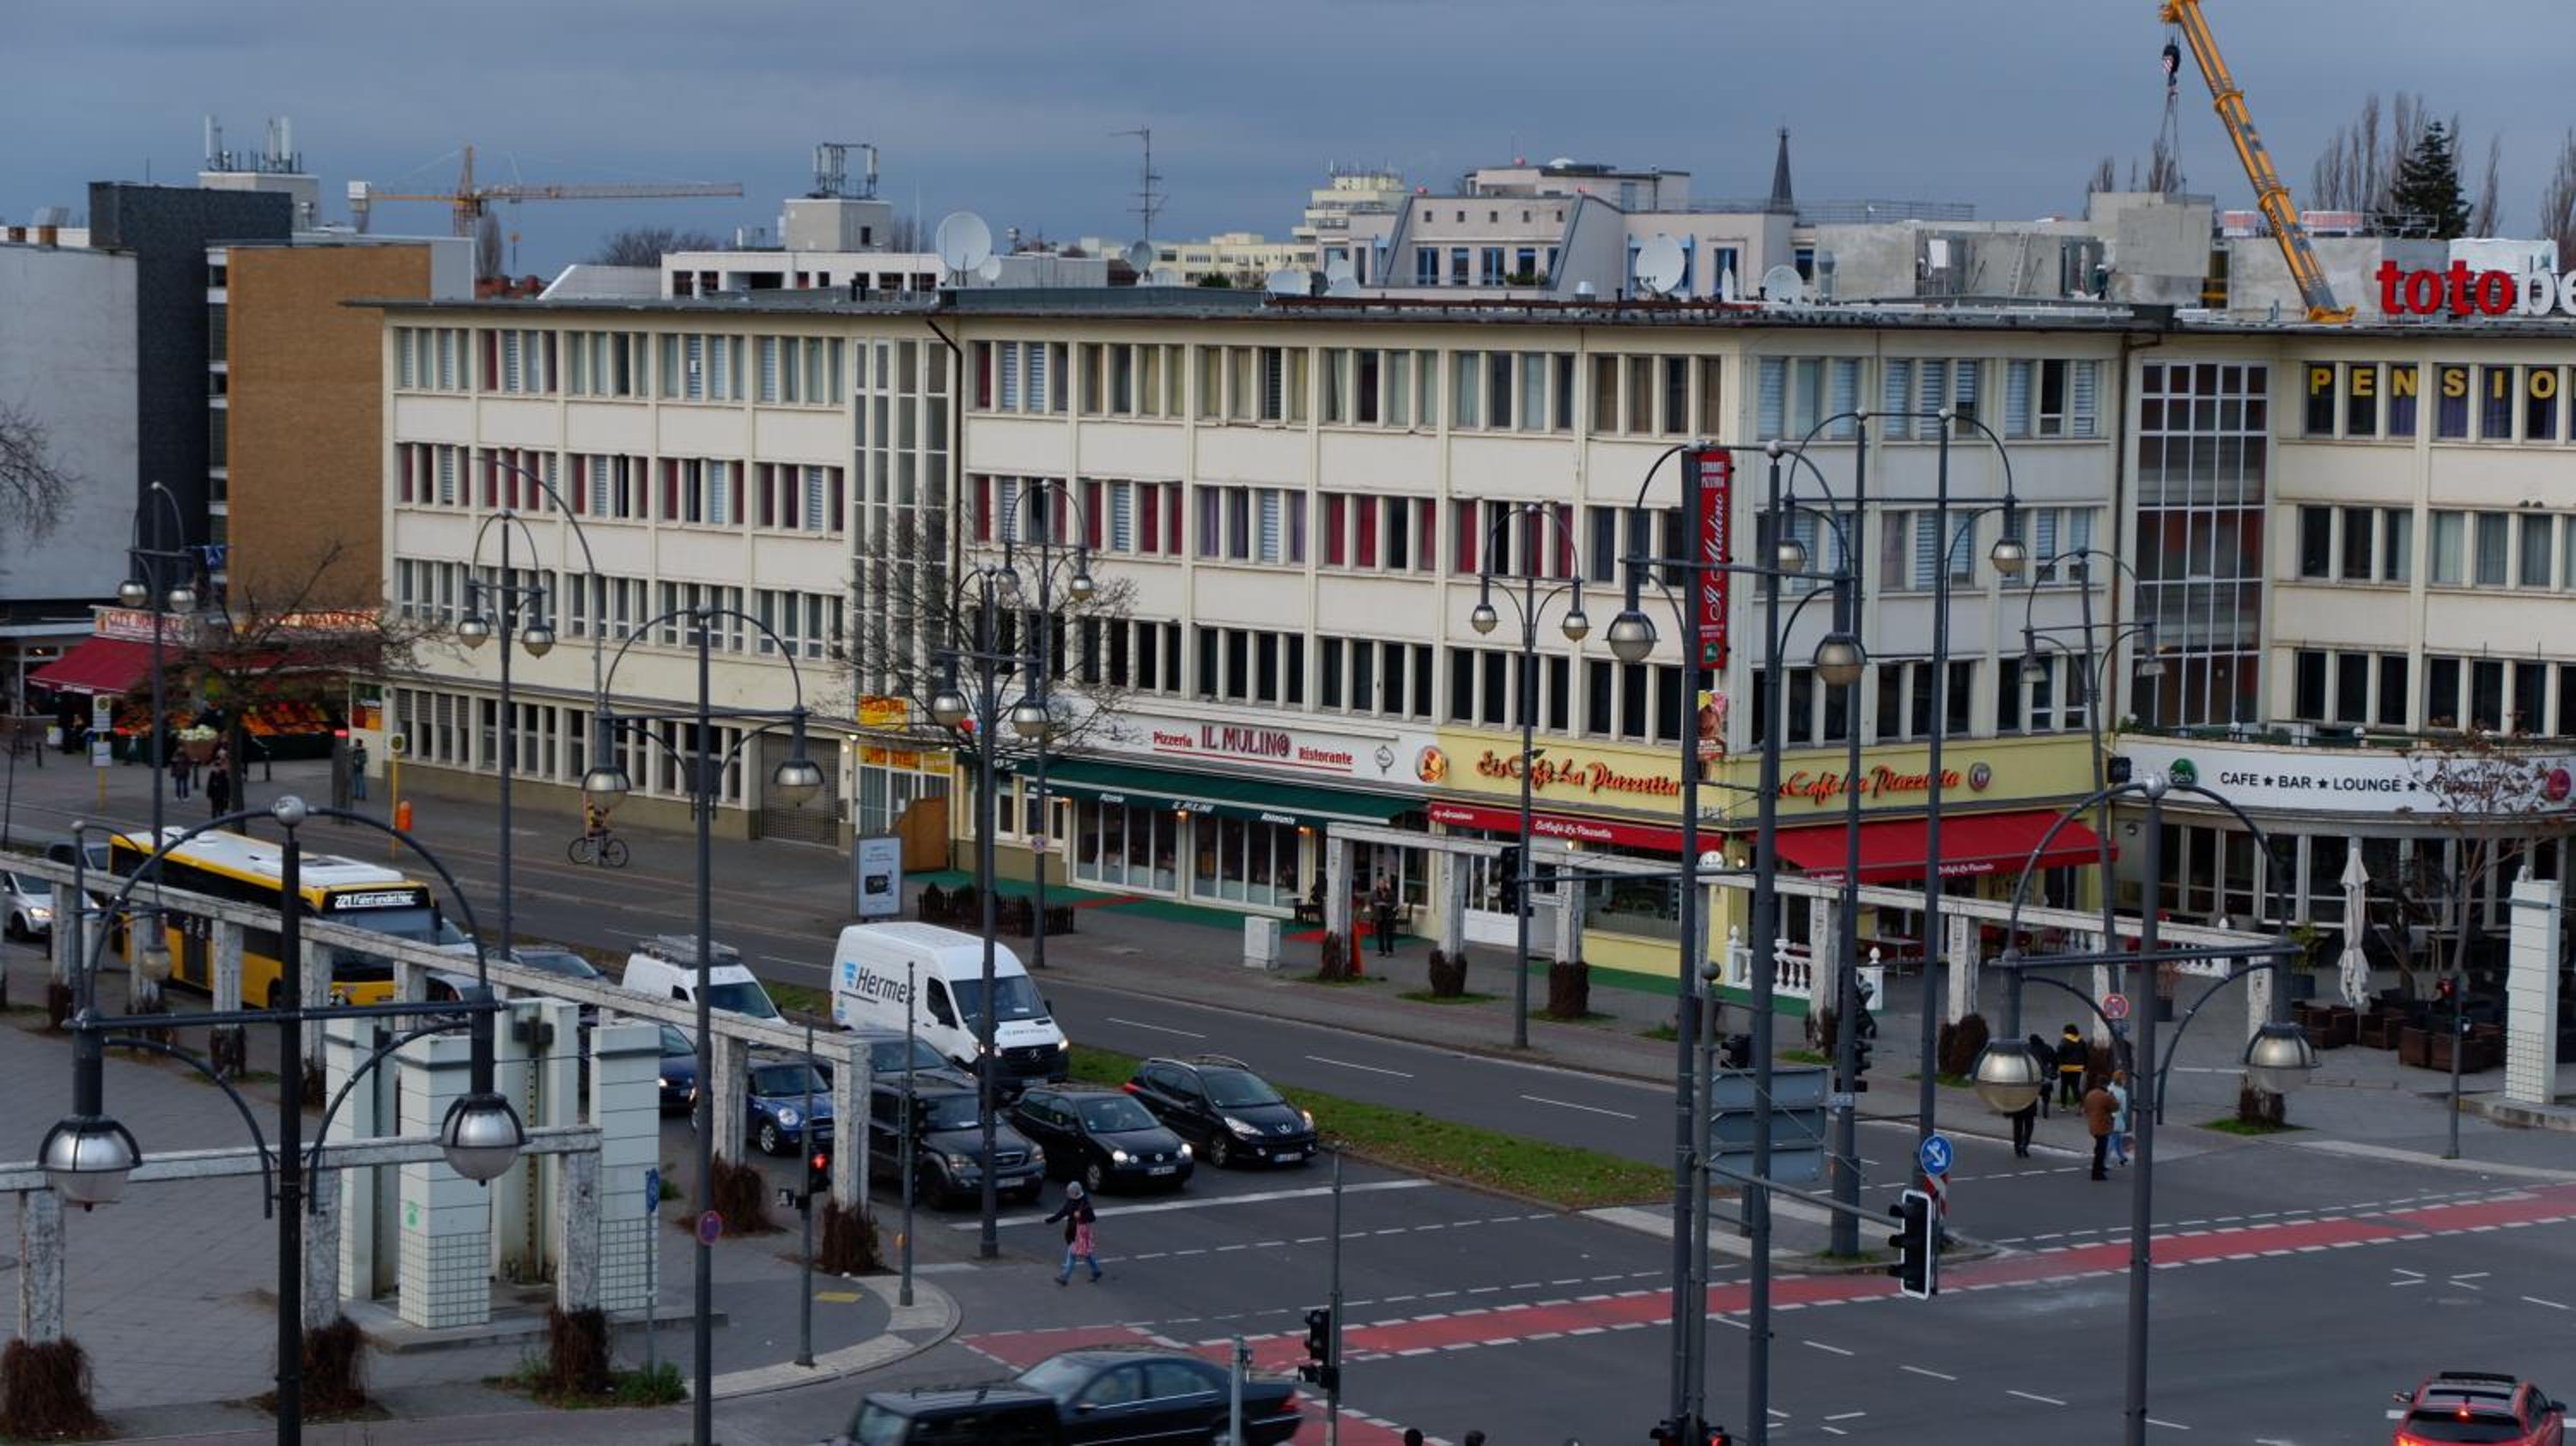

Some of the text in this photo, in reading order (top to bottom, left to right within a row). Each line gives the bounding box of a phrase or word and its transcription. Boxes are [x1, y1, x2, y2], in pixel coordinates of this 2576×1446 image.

[2312, 368, 2576, 398] PENSIO
[1154, 725, 1353, 765] Pizzeria IL MULINO Ristorante
[1587, 762, 1680, 795] Piazzetta
[2221, 772, 2402, 792] CAFE BAR LOUNGE
